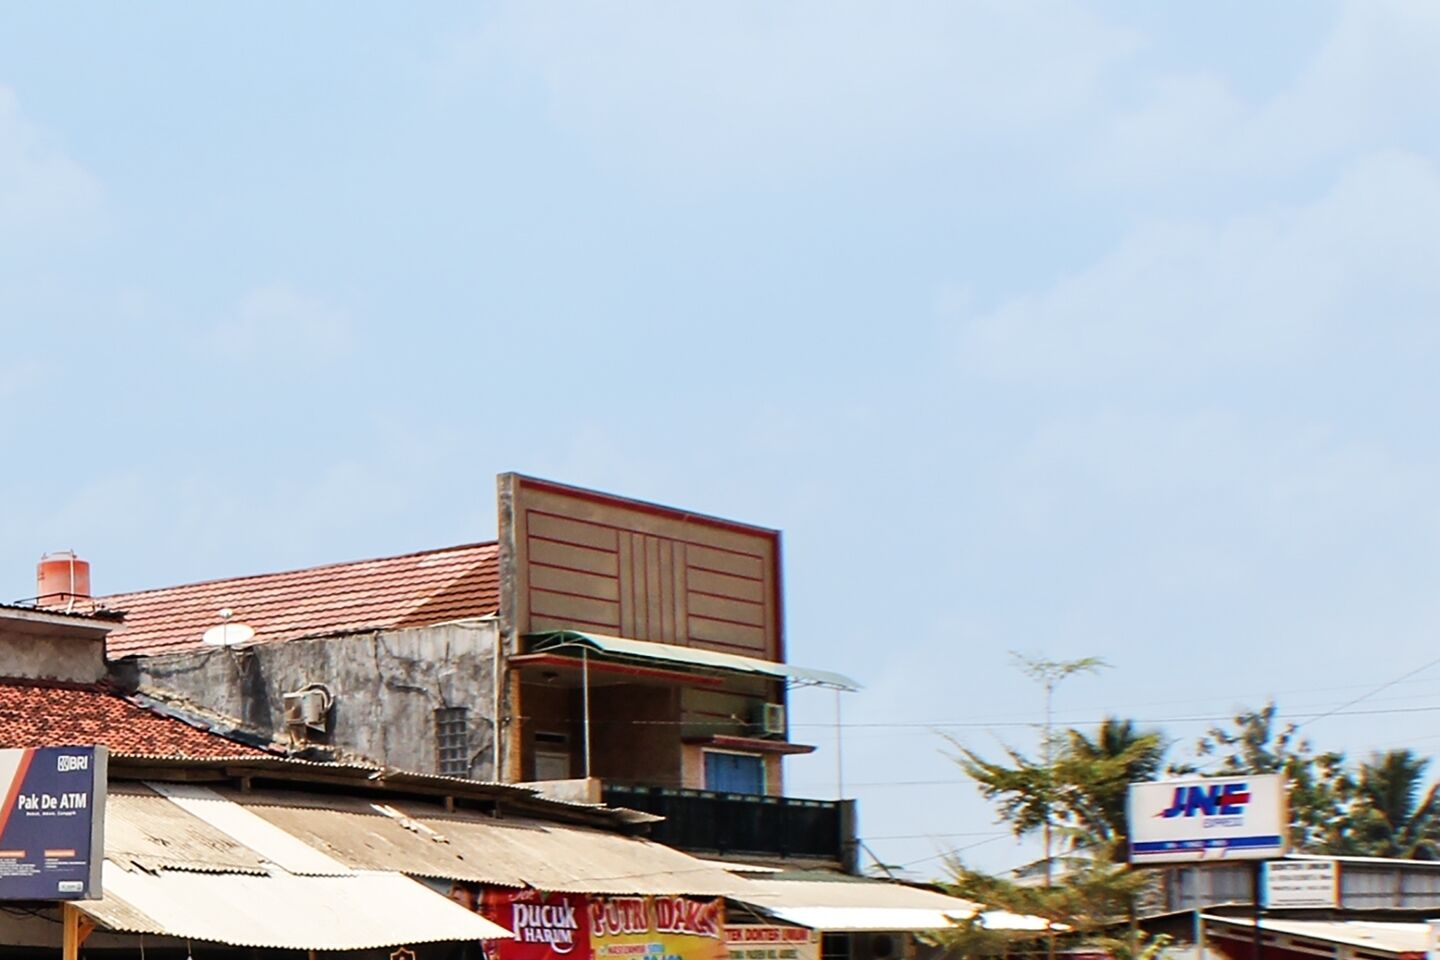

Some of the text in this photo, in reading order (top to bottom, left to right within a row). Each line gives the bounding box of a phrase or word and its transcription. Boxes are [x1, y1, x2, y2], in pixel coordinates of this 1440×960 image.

[18, 792, 87, 811] Pak De ATM
[1161, 783, 1251, 818] JNE
[591, 897, 649, 936] PUTRI
[525, 927, 574, 948] HARUM
